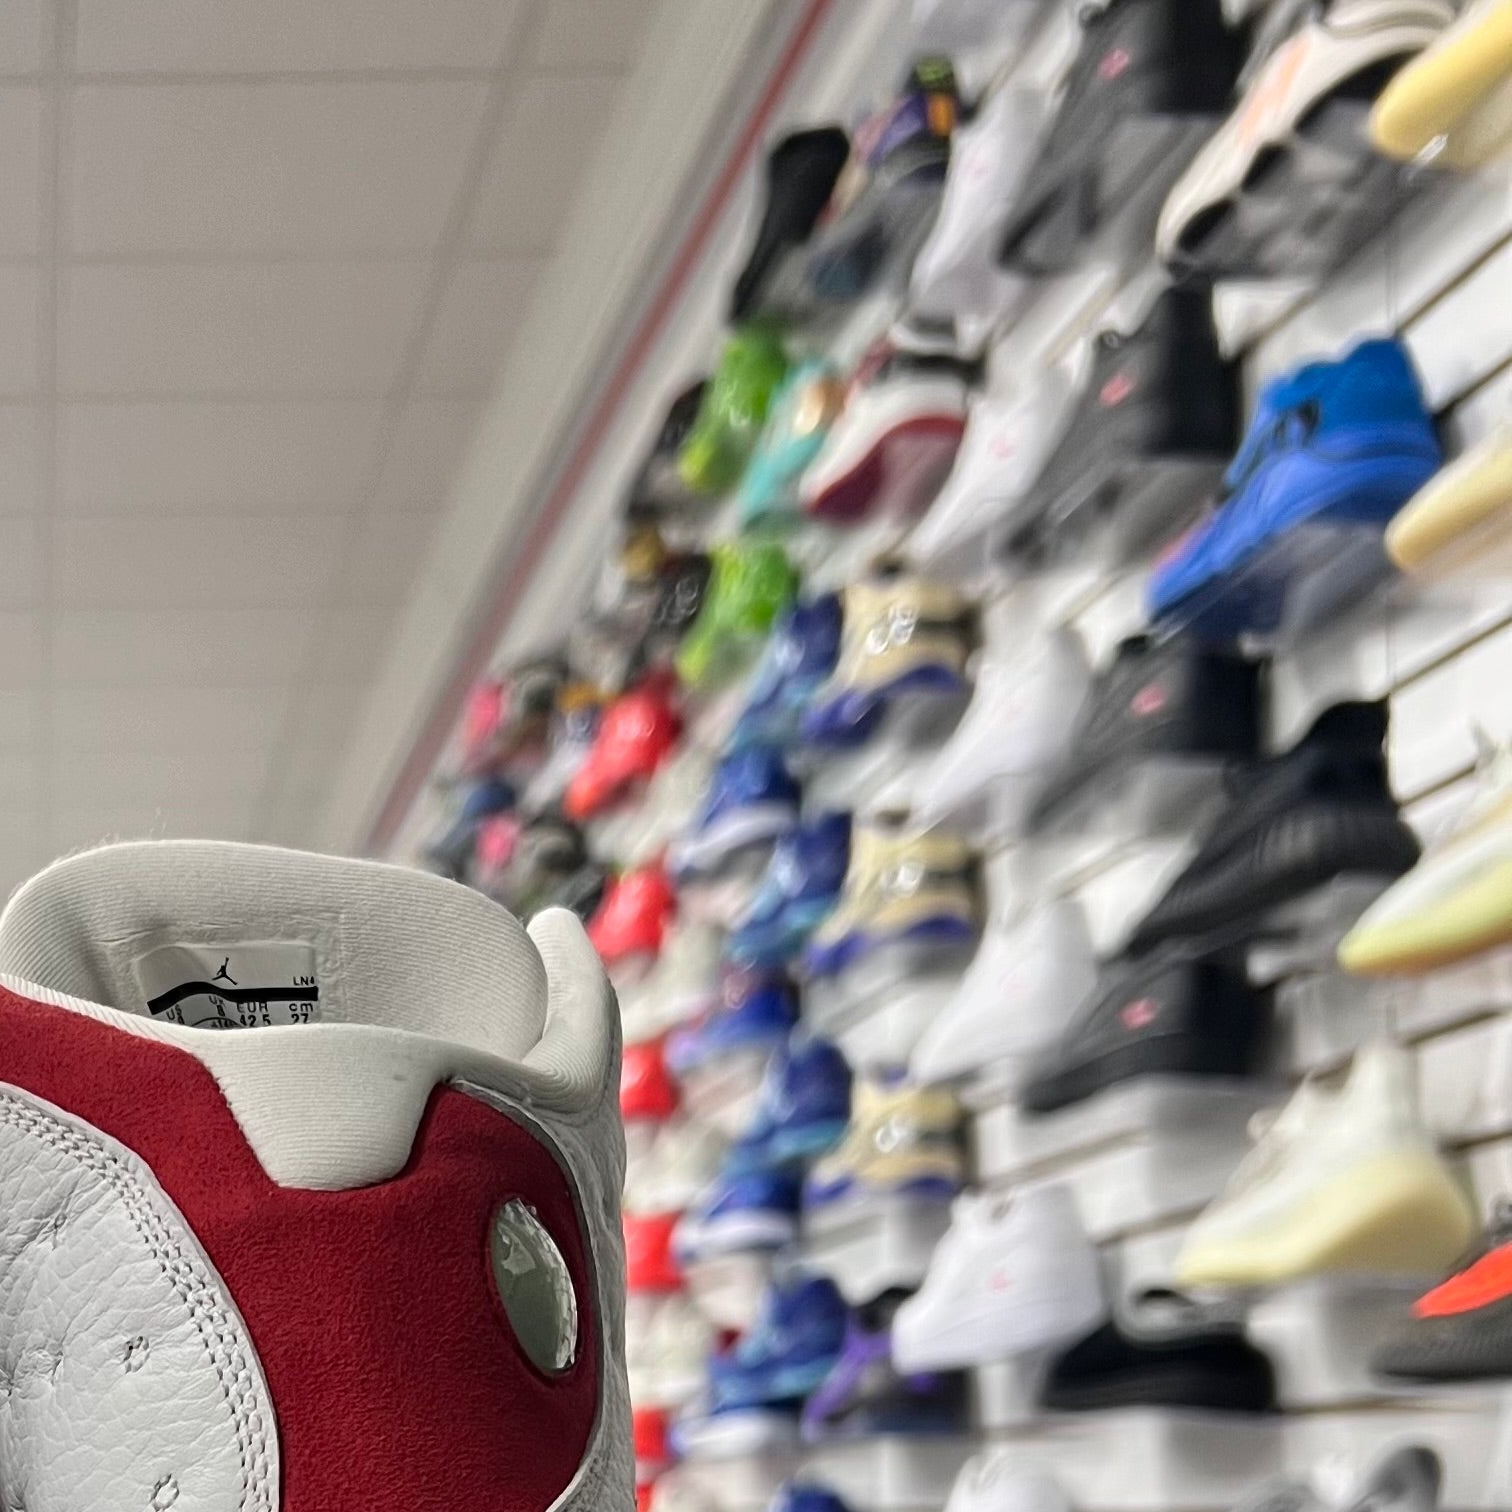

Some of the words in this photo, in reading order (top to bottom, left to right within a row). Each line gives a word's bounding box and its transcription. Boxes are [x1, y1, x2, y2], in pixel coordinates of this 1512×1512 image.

[166, 1004, 182, 1020] US
[236, 1001, 268, 1013] EUR
[289, 1003, 313, 1013] cm
[240, 1014, 271, 1027] 425
[291, 1013, 309, 1025] 27
